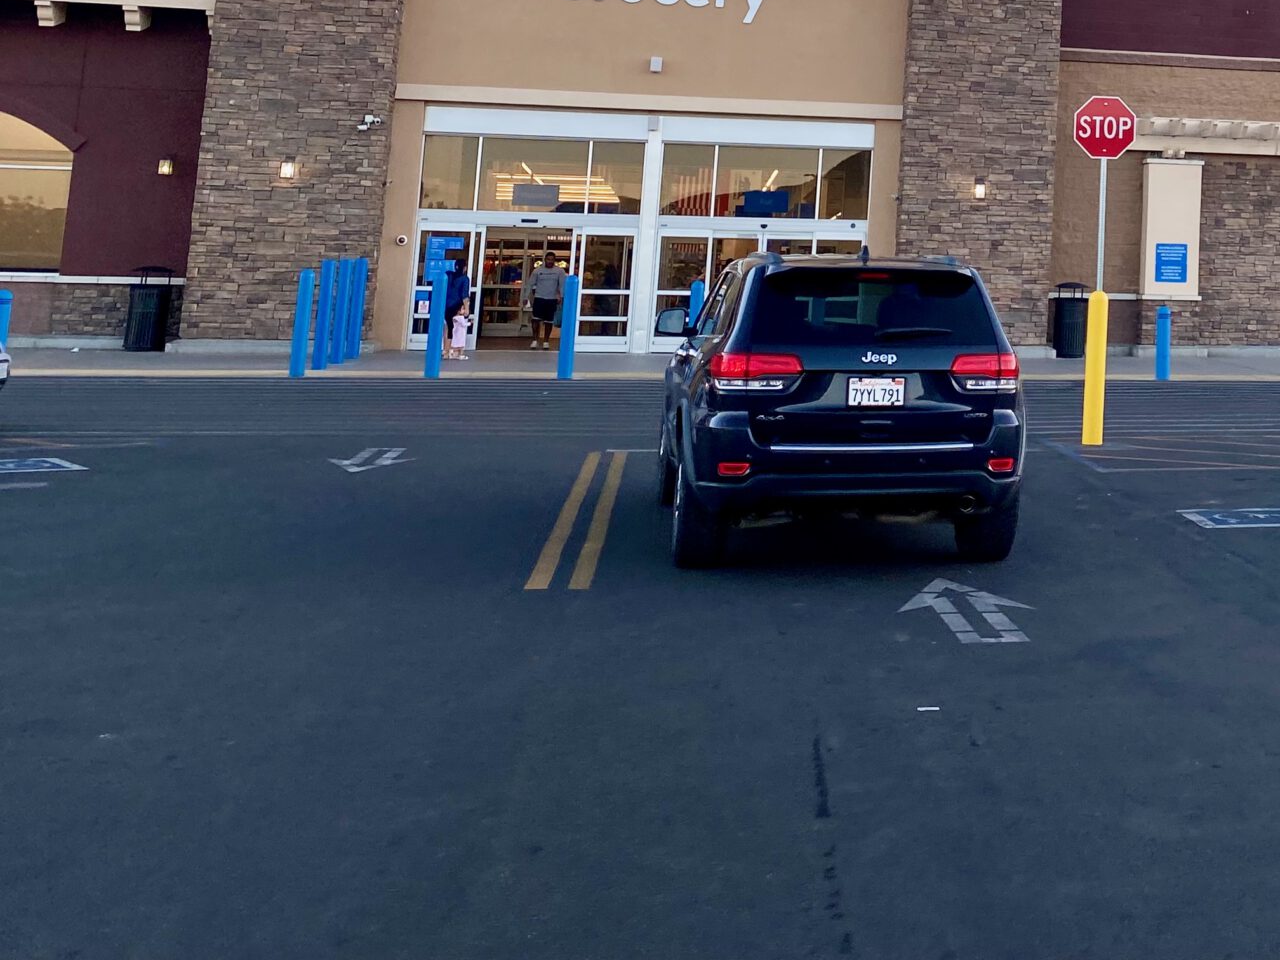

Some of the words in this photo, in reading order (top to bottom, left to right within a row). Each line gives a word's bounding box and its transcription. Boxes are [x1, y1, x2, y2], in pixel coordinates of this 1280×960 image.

[1078, 115, 1132, 139] STOP
[861, 351, 897, 365] Jeep
[851, 388, 901, 403] 7YYL791
